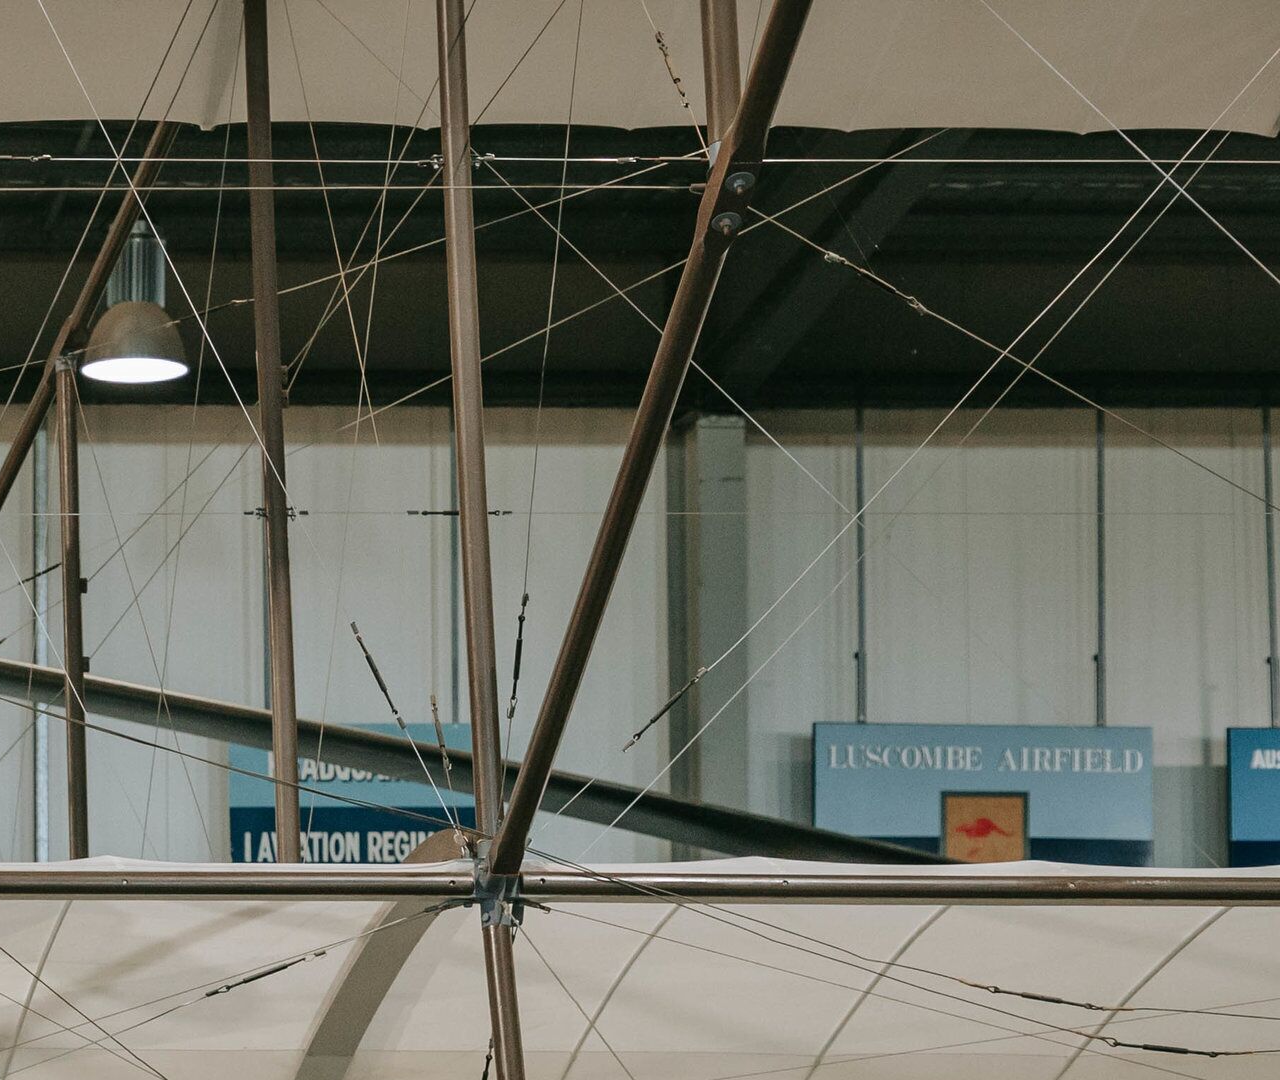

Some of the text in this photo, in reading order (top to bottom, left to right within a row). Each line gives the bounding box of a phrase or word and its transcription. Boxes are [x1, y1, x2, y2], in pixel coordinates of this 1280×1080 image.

[829, 744, 1144, 774] LUSCOMBE AIRFIELD
[256, 831, 361, 863] AATION
